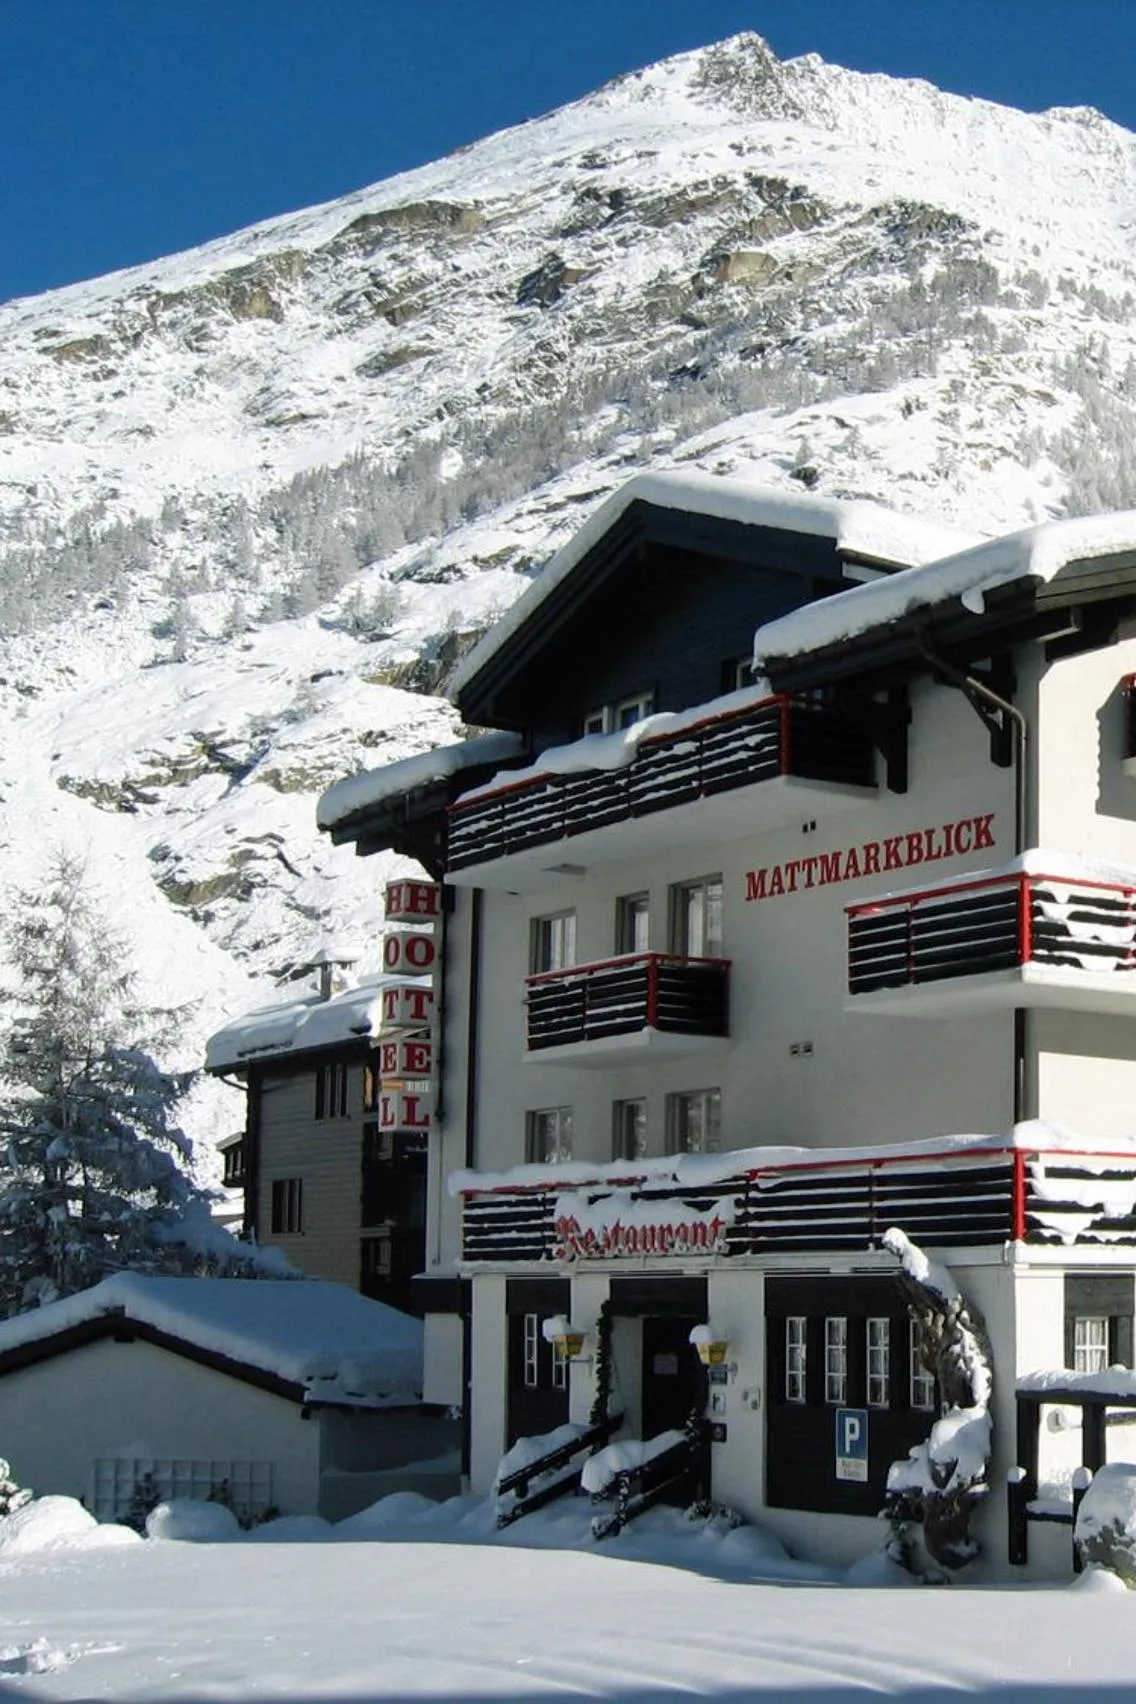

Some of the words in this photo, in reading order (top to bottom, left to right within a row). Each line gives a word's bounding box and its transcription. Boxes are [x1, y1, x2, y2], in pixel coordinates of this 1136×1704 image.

[745, 814, 995, 901] MATTMARKBLICK
[381, 883, 403, 1127] HOTEL
[402, 883, 439, 1127] HOTEL
[555, 1214, 726, 1258] Restaurant
[845, 1417, 860, 1453] P
